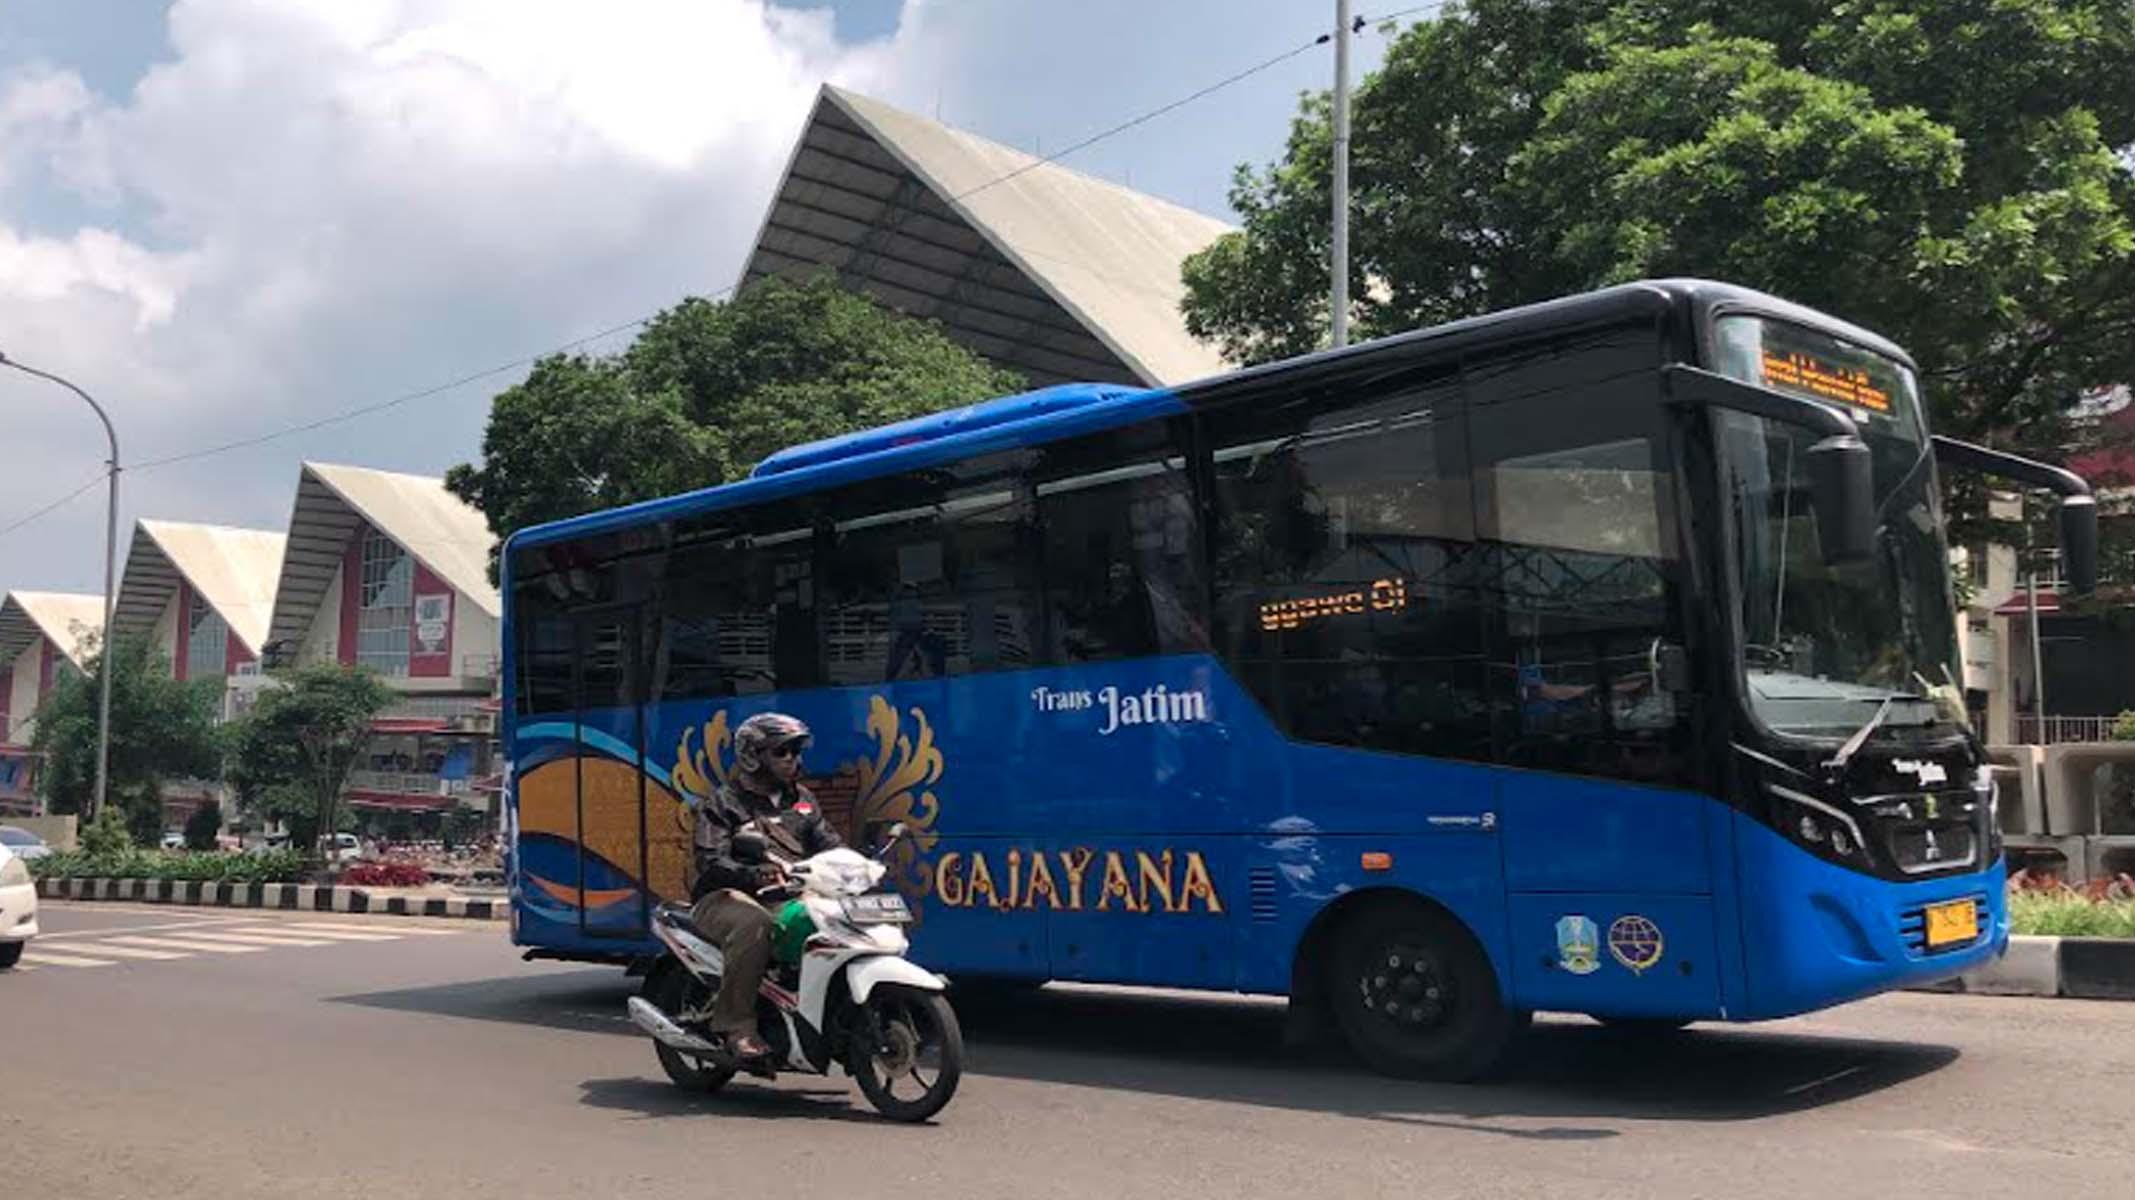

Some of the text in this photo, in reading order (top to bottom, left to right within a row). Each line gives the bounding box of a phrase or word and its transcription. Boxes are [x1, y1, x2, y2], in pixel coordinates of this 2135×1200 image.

[1031, 683, 1207, 736] Trans Jatim
[935, 847, 1223, 913] GAJAYANA
